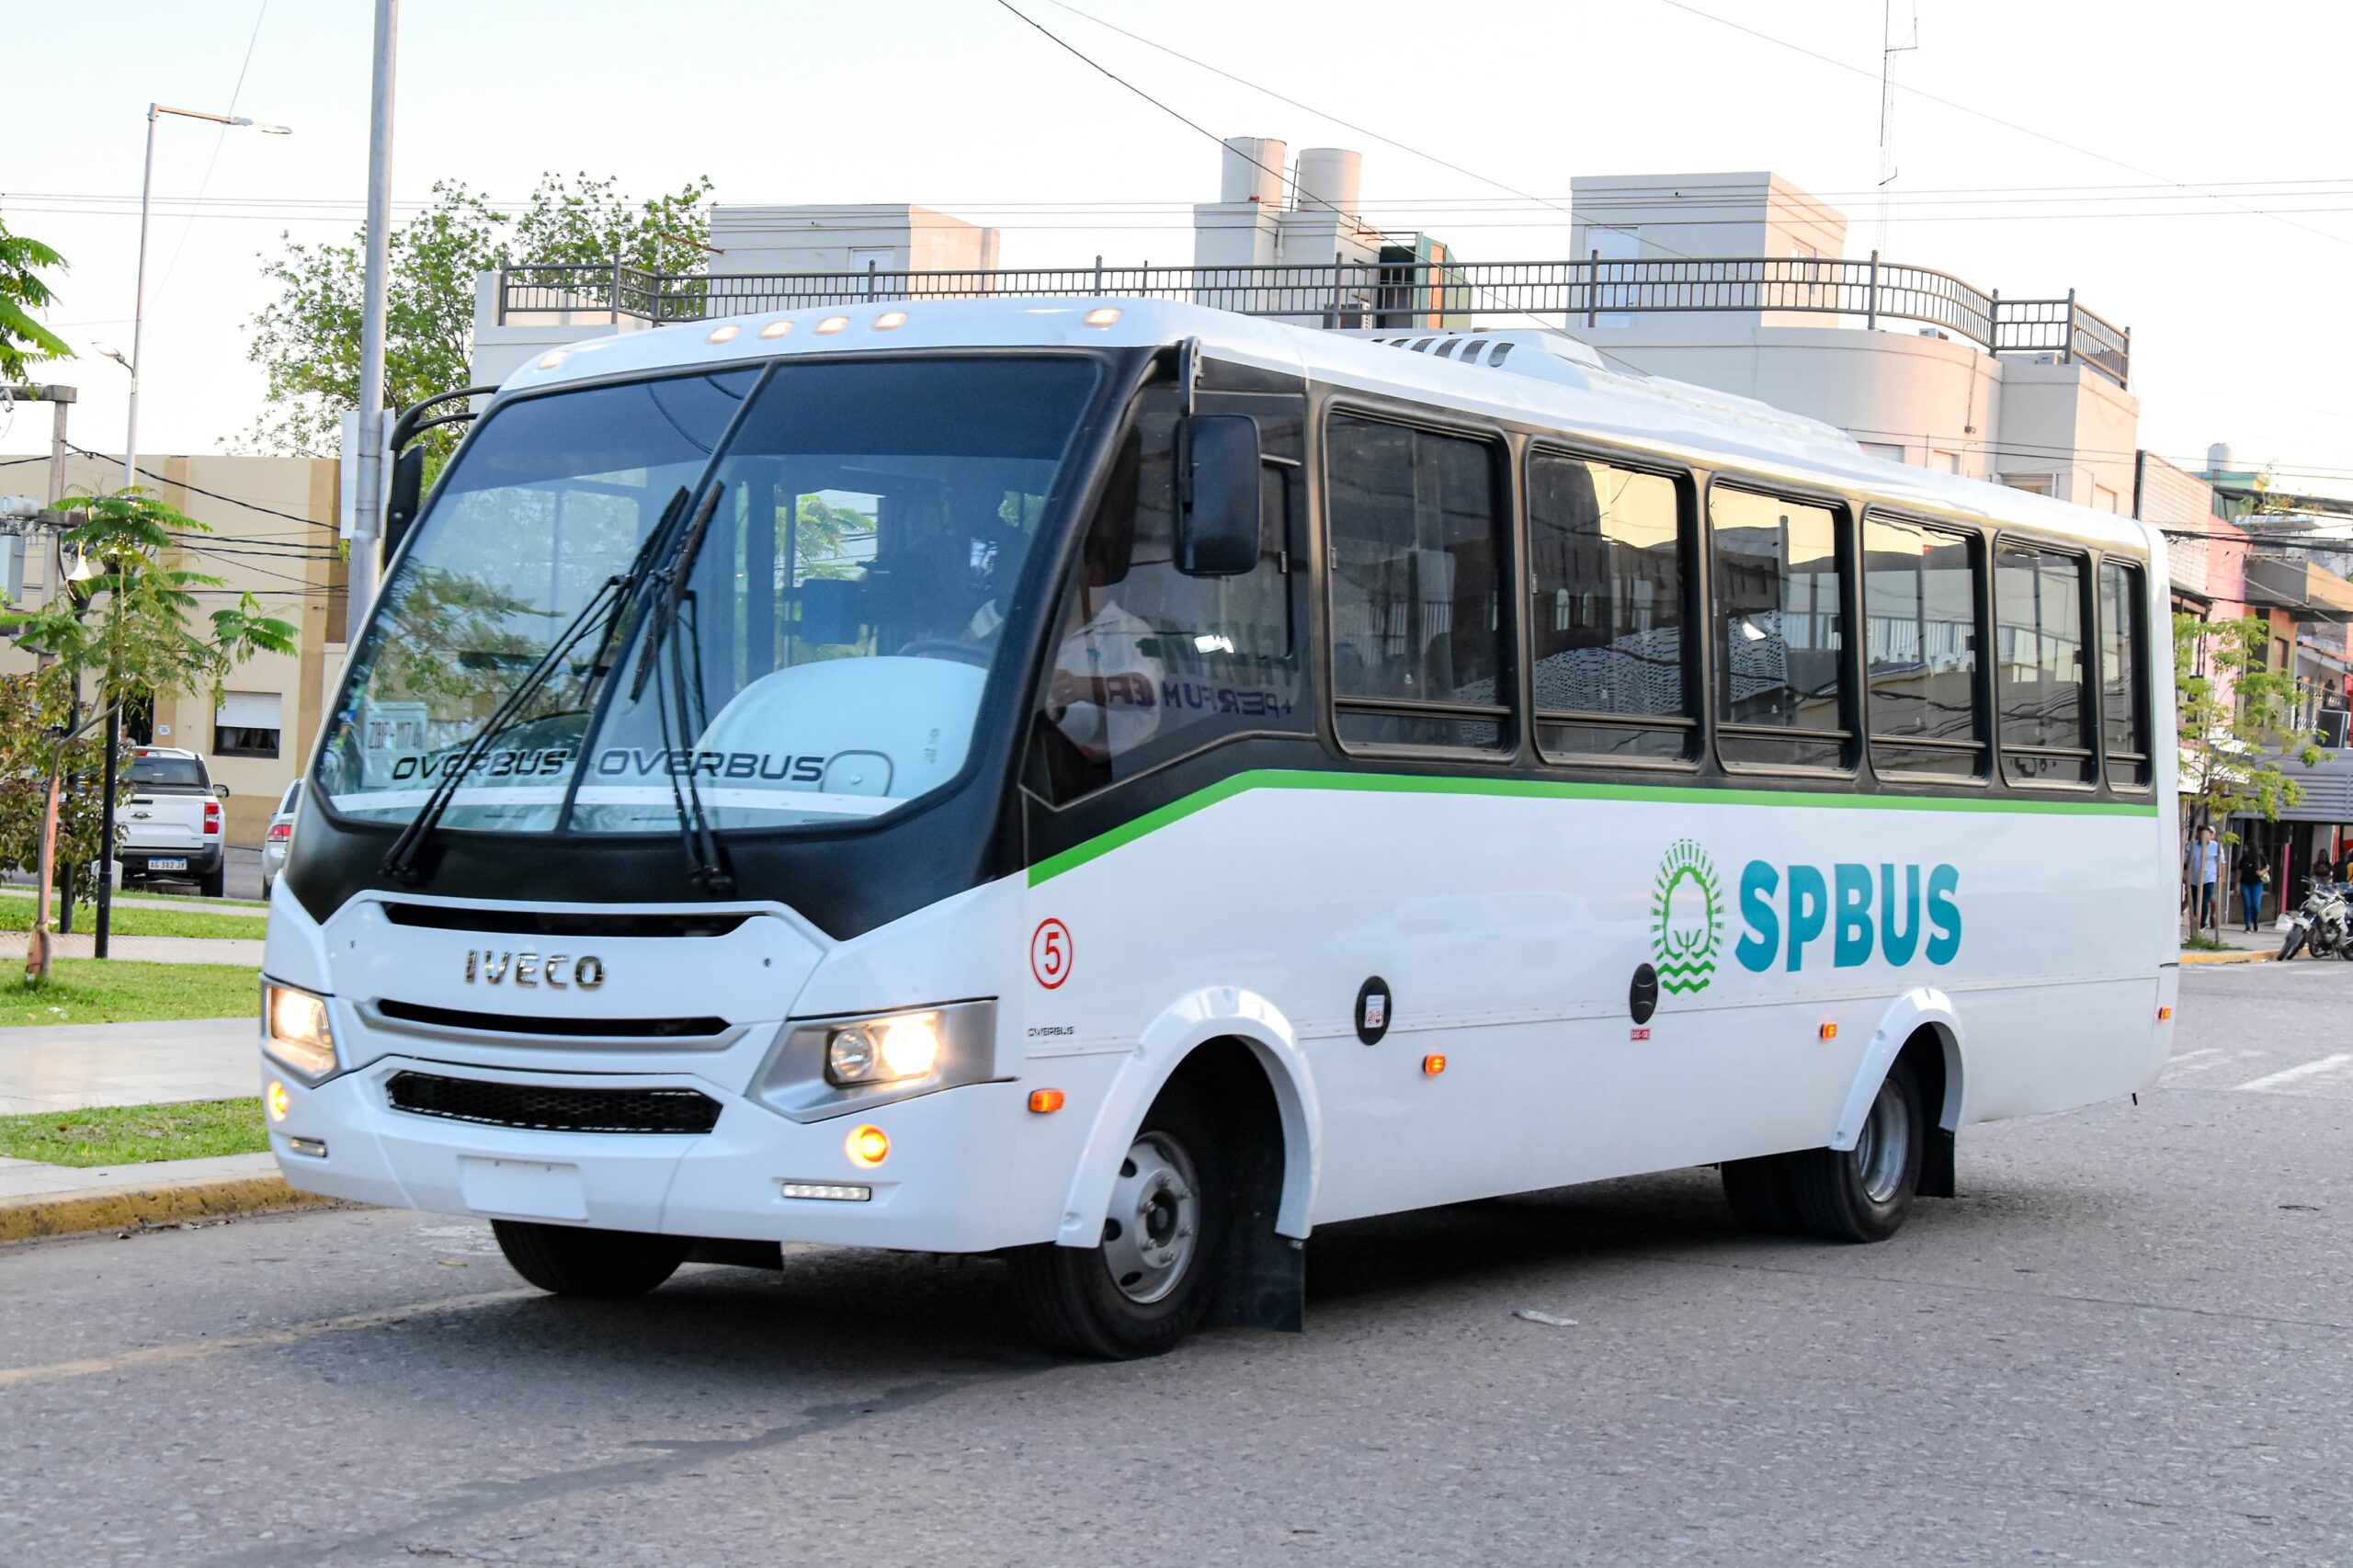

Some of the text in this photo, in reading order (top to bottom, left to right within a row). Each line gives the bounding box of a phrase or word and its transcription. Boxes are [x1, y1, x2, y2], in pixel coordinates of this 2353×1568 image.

[598, 749, 824, 781] OVERBUS
[1734, 859, 1961, 972] SPBUS
[465, 949, 606, 991] IVECO
[1044, 932, 1062, 975] 5
[1028, 1026, 1074, 1037] OVERBUS
